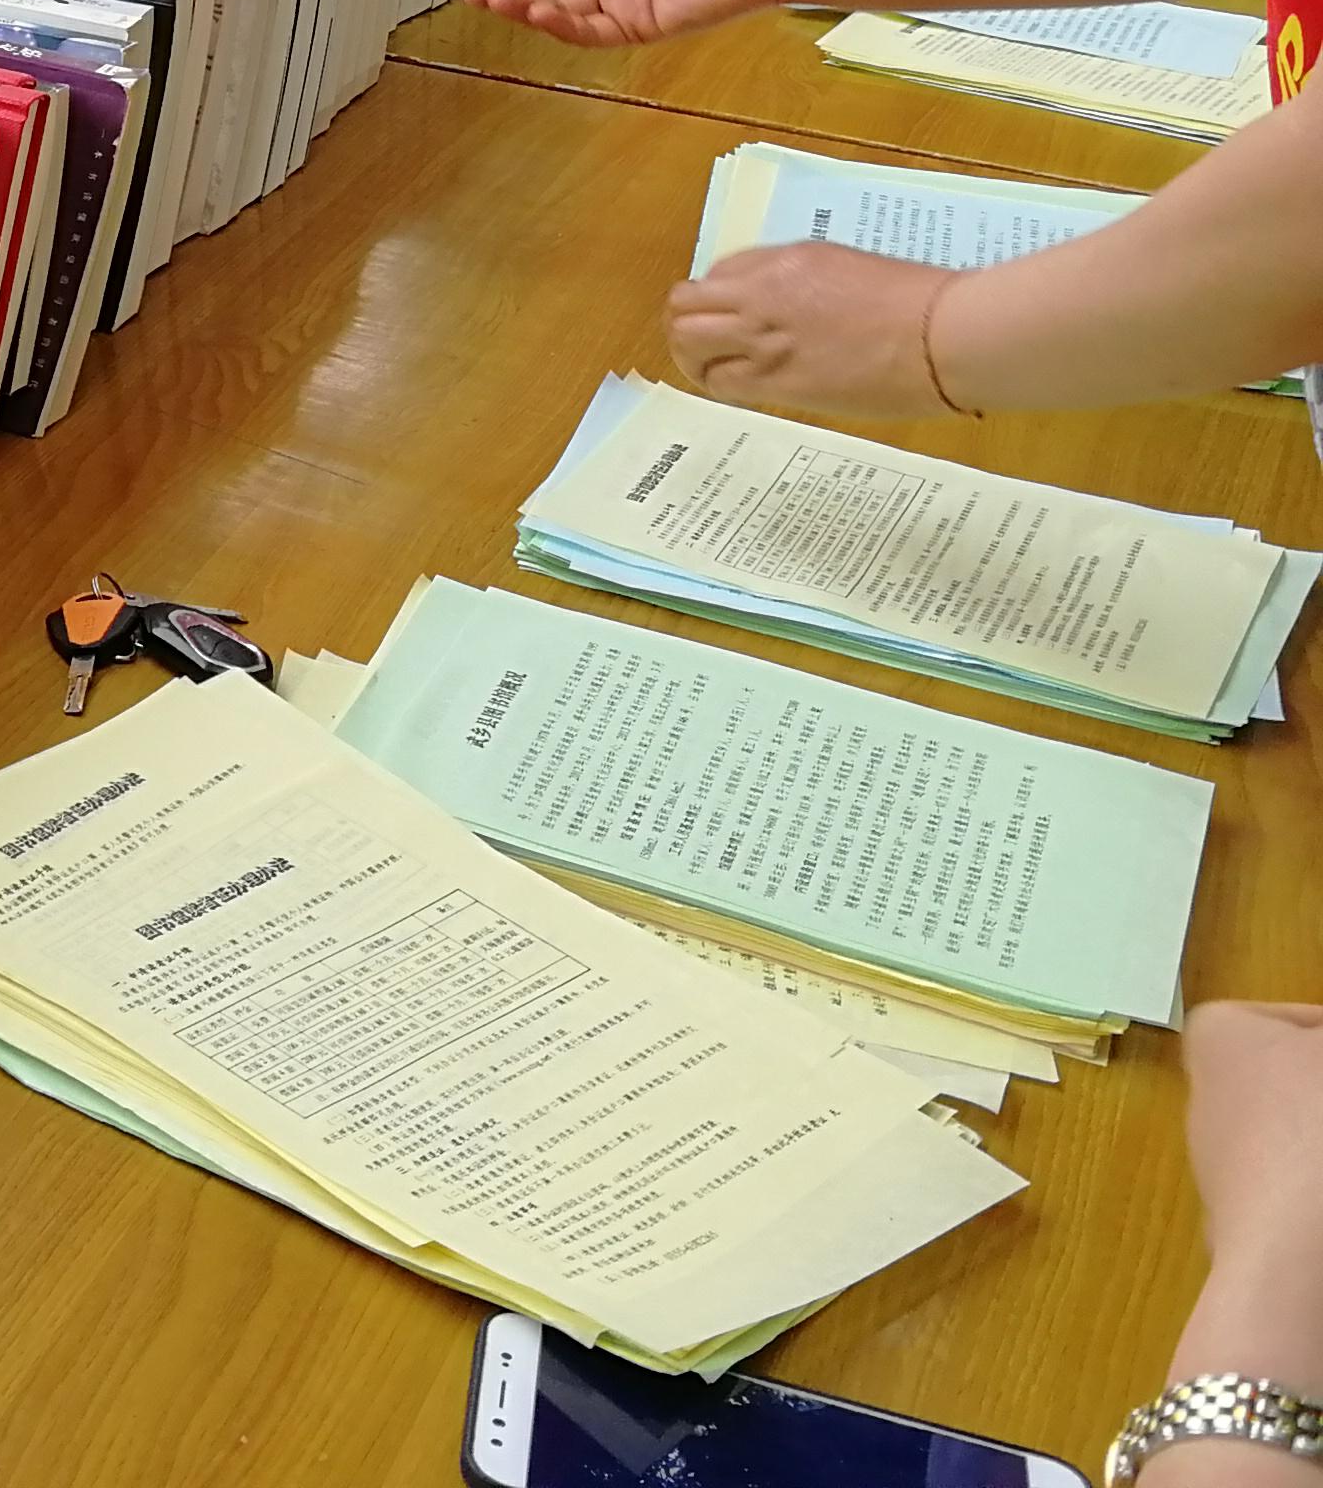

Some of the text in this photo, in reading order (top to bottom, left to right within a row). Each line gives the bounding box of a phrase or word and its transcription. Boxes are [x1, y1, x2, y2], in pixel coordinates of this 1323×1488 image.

[462, 669, 529, 749] 武乡县图书馆概况
[131, 855, 298, 941] 图书馆读者证办理办法
